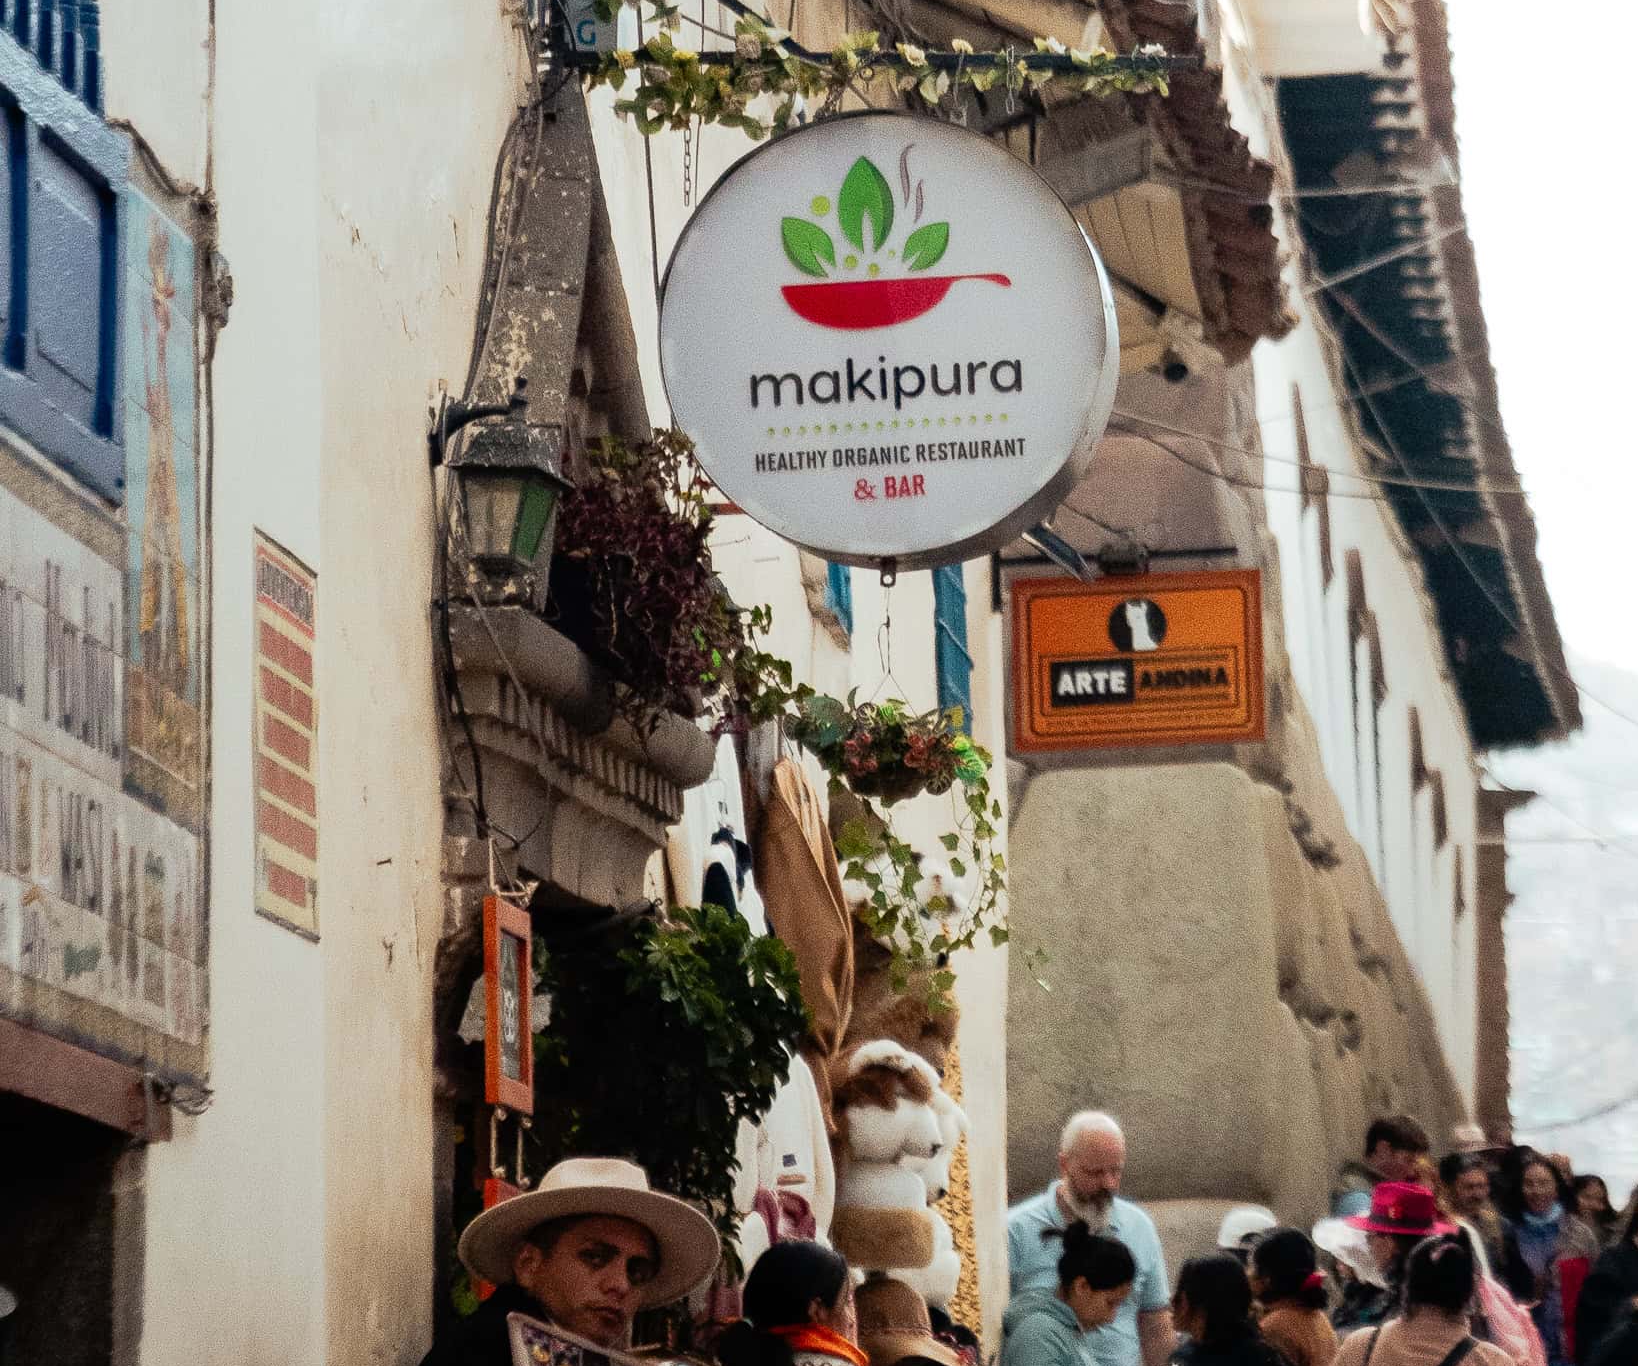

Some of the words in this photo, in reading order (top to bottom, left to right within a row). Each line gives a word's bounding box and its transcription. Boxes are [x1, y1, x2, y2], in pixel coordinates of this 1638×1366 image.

[750, 353, 1025, 411] makipura
[754, 448, 827, 473] HEALTHY
[832, 444, 911, 469] ORGANIC
[915, 437, 1026, 464] RESTAURANT
[853, 478, 876, 501] &
[884, 474, 926, 500] BAR
[1057, 668, 1128, 696] ARTE
[1139, 666, 1229, 688] ANDINA
